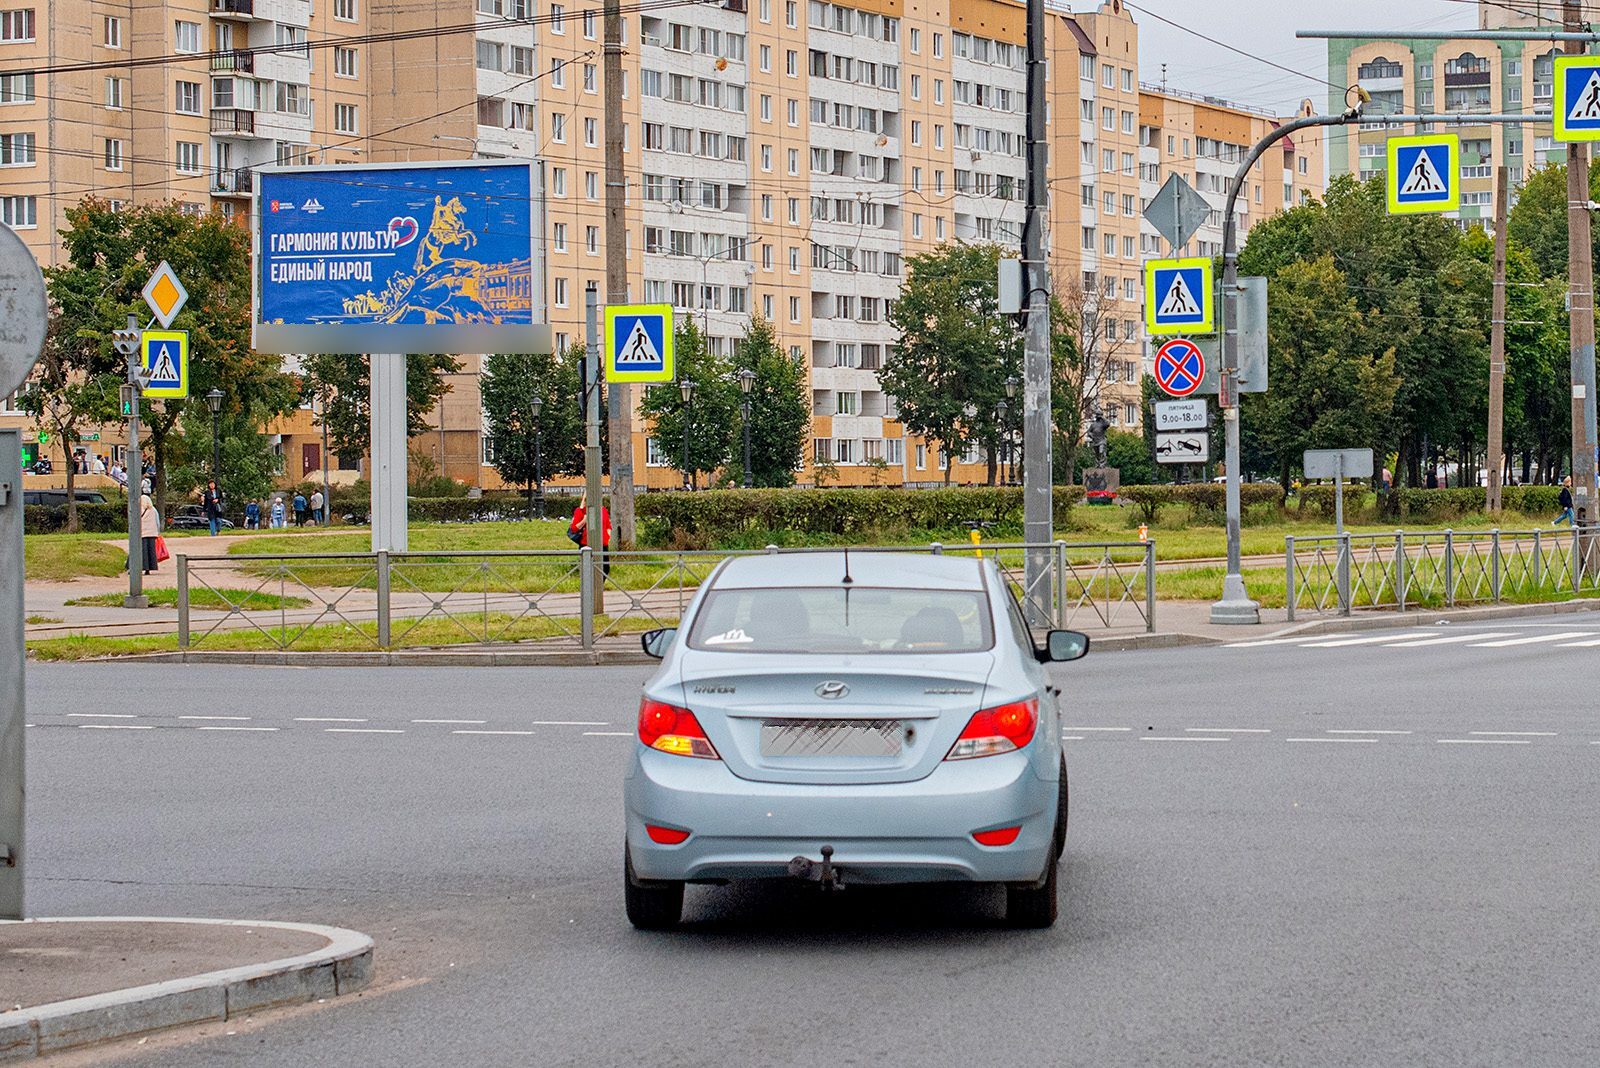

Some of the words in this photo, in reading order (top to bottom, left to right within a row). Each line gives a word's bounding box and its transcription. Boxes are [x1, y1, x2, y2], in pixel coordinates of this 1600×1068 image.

[270, 232, 338, 252] ГАРМОНИЯ
[341, 230, 400, 250] КУЛЬТУР
[270, 259, 326, 283] ЕДИНЫЙ
[329, 261, 373, 282] НАРОД
[1161, 412, 1203, 424] 9.00-18.00
